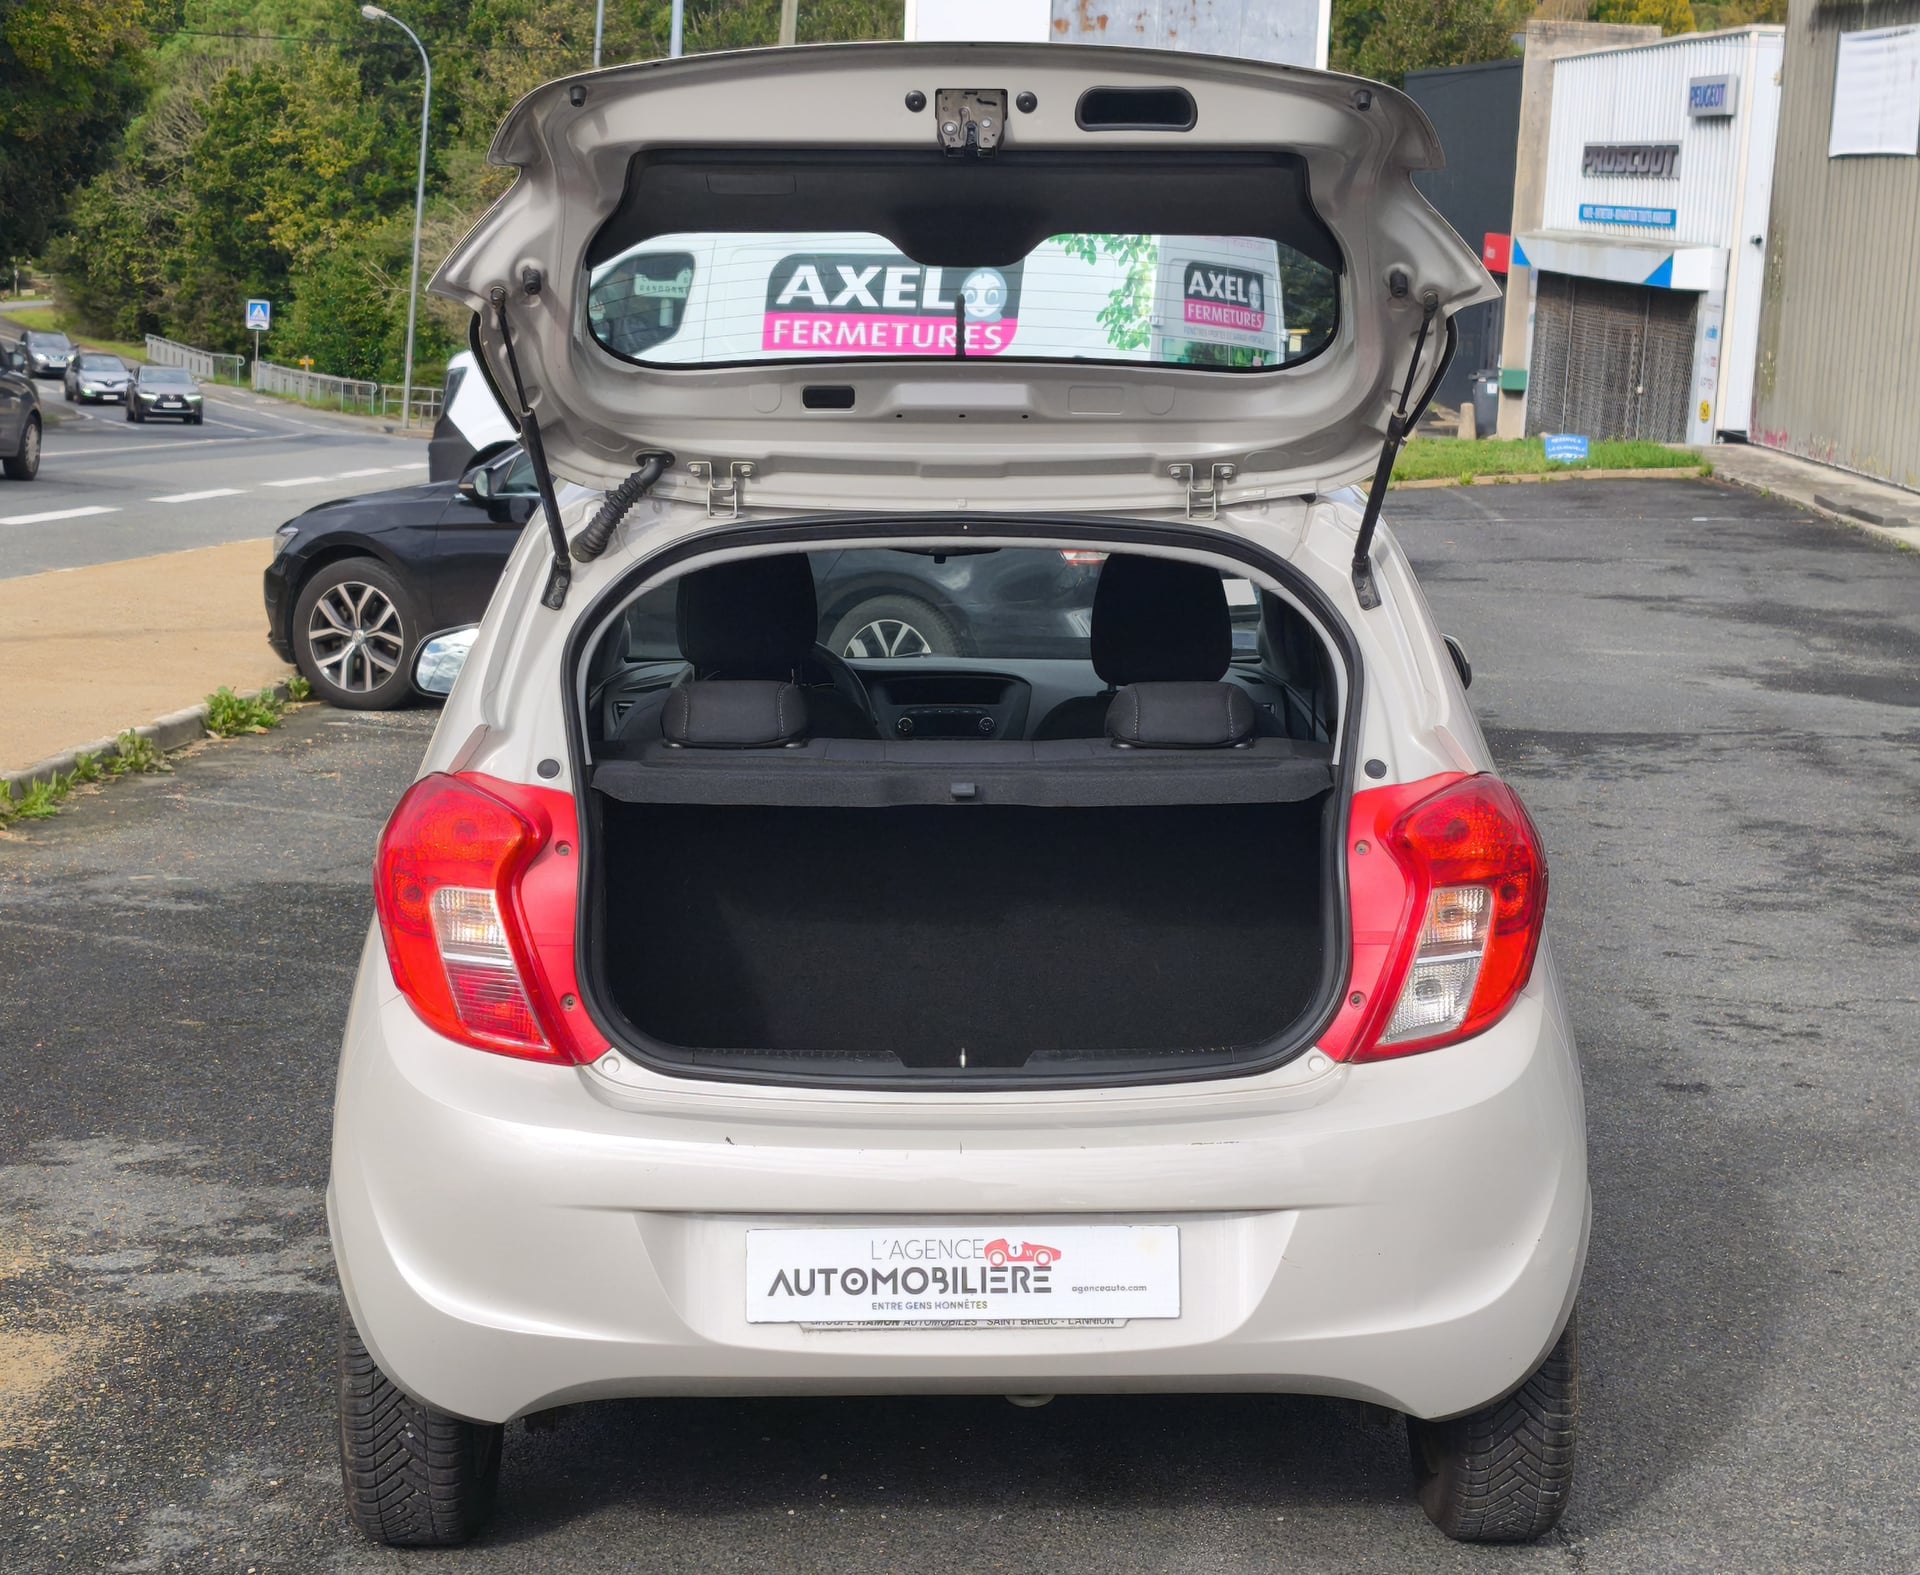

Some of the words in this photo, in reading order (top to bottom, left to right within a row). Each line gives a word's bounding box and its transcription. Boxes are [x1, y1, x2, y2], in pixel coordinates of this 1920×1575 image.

[1689, 83, 1726, 108] PEUGEOT
[1582, 145, 1680, 175] PROSCOOT
[776, 264, 956, 310] AXEL
[1188, 269, 1249, 304] AXEL
[1187, 302, 1263, 329] FERMETURES
[773, 319, 1003, 351] FERMETURES
[871, 1239, 985, 1260] L'AGENCE
[1071, 1284, 1147, 1294] agenceauto.com
[872, 1301, 903, 1310] ENTRE
[905, 1301, 932, 1310] GENS
[935, 1299, 988, 1310] HONNÊTES
